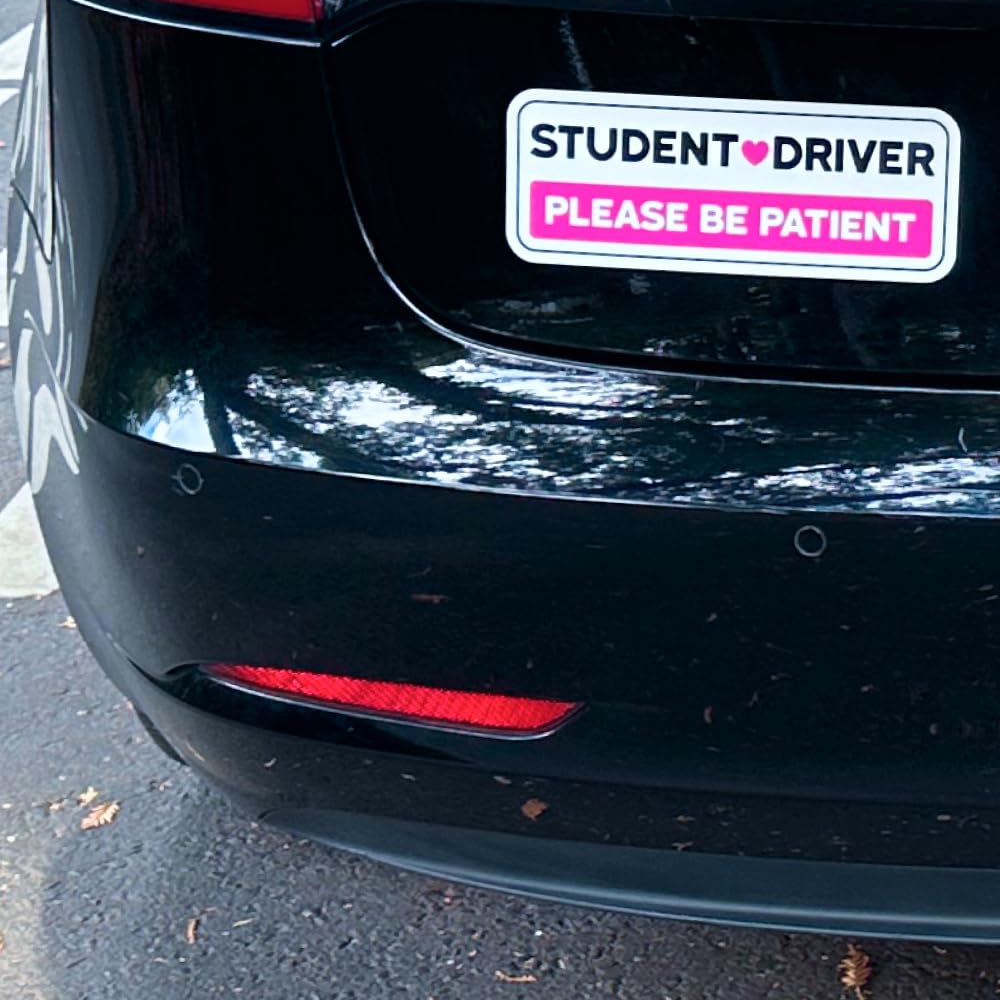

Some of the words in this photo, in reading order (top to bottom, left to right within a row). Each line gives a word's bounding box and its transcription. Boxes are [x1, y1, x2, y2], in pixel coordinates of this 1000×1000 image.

[530, 123, 739, 167] STUDENT
[773, 135, 935, 177] DRIVER
[544, 195, 689, 233] PLEASE
[699, 203, 749, 236] BE
[759, 206, 917, 243] PATIENT
